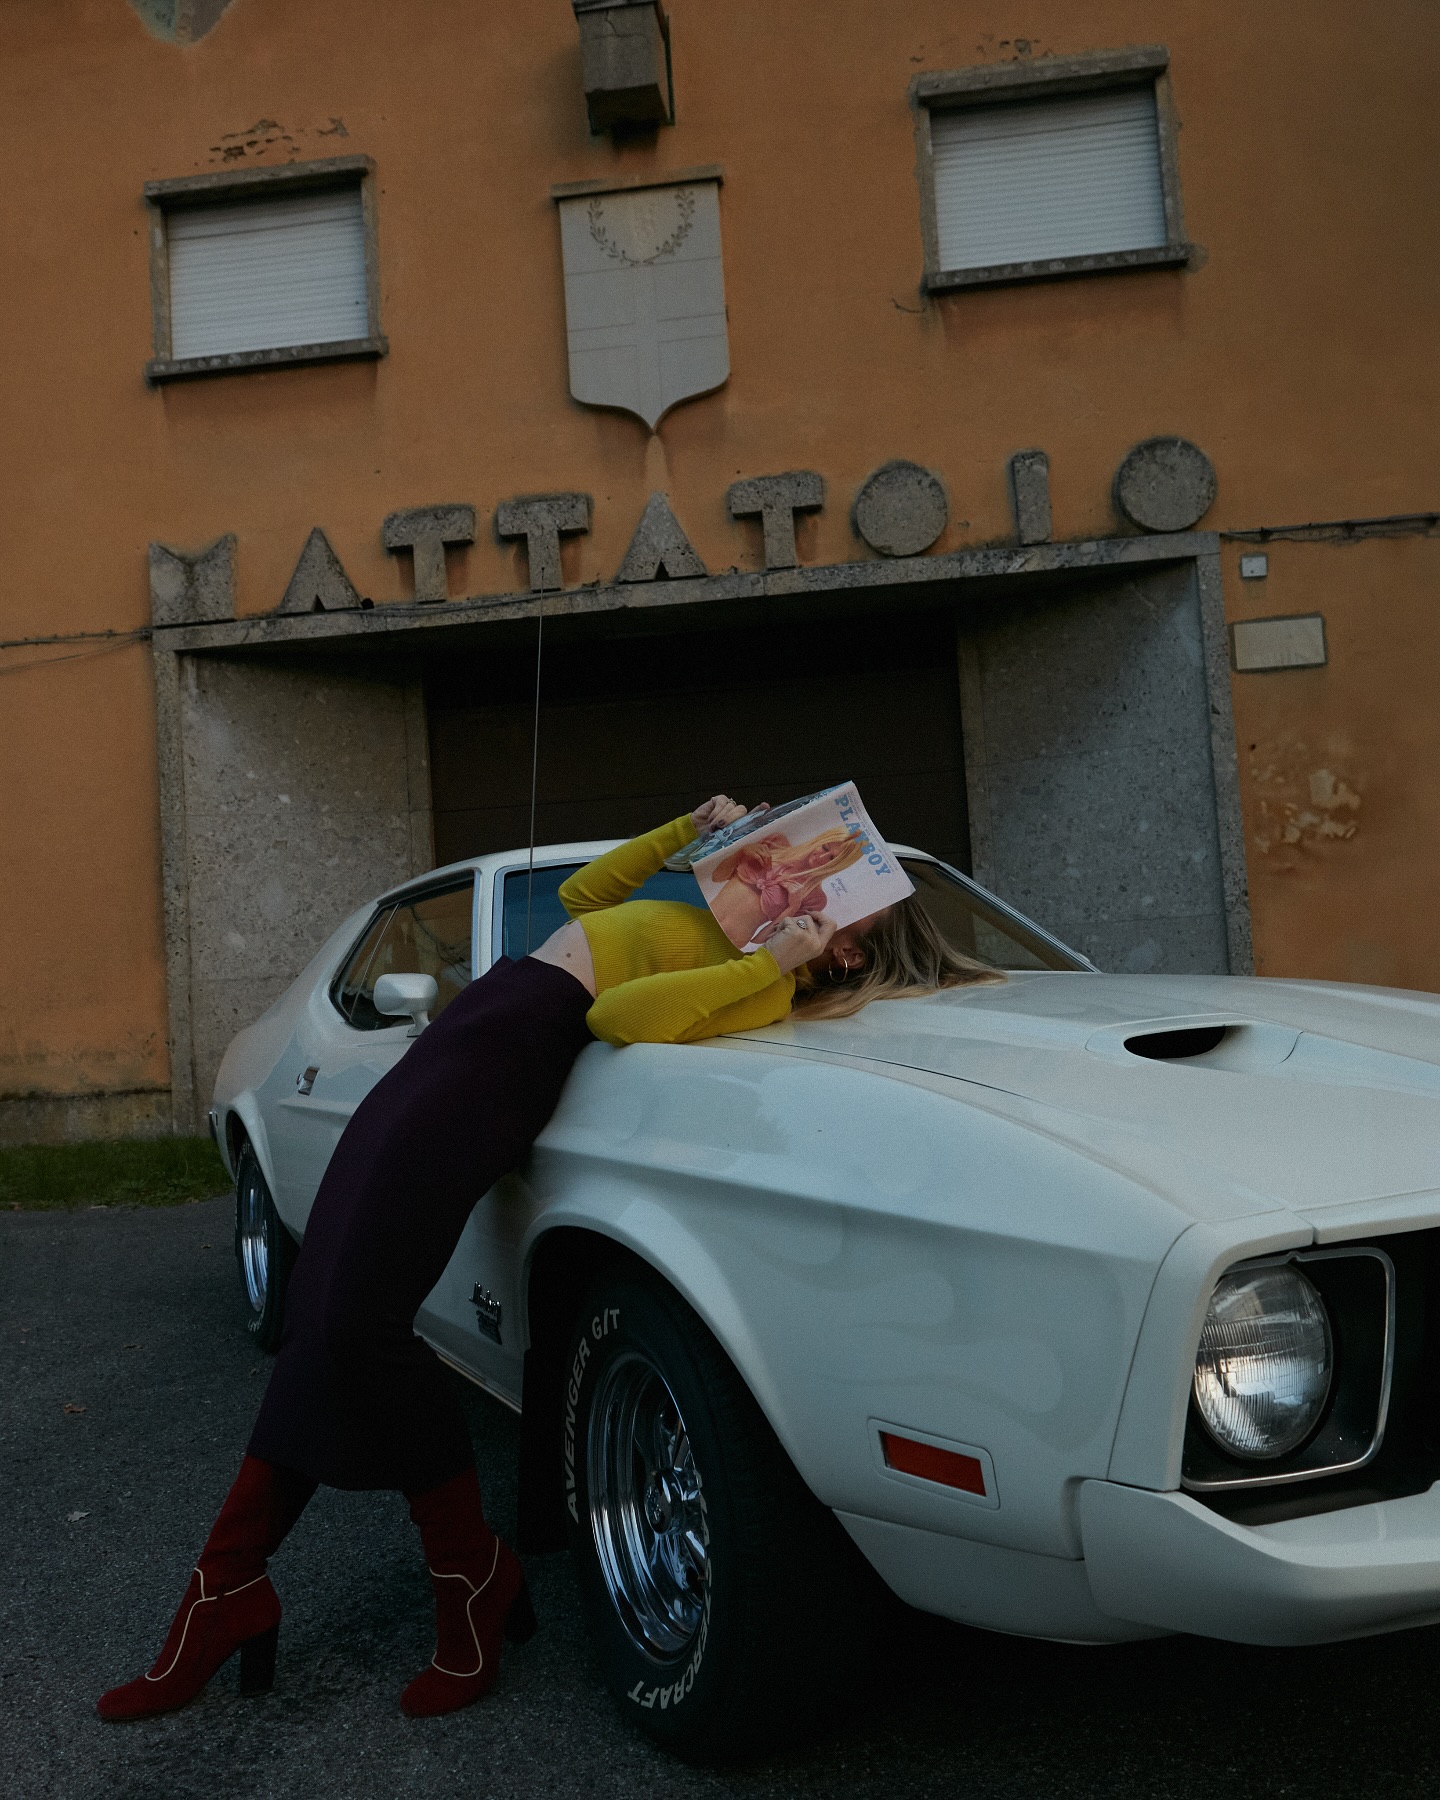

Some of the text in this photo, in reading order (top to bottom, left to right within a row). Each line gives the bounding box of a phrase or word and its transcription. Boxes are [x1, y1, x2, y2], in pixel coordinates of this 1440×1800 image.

[148, 434, 1216, 628] MATTATOIO
[834, 793, 892, 876] PLAYBOY
[563, 1306, 621, 1524] AVENGER G/T
